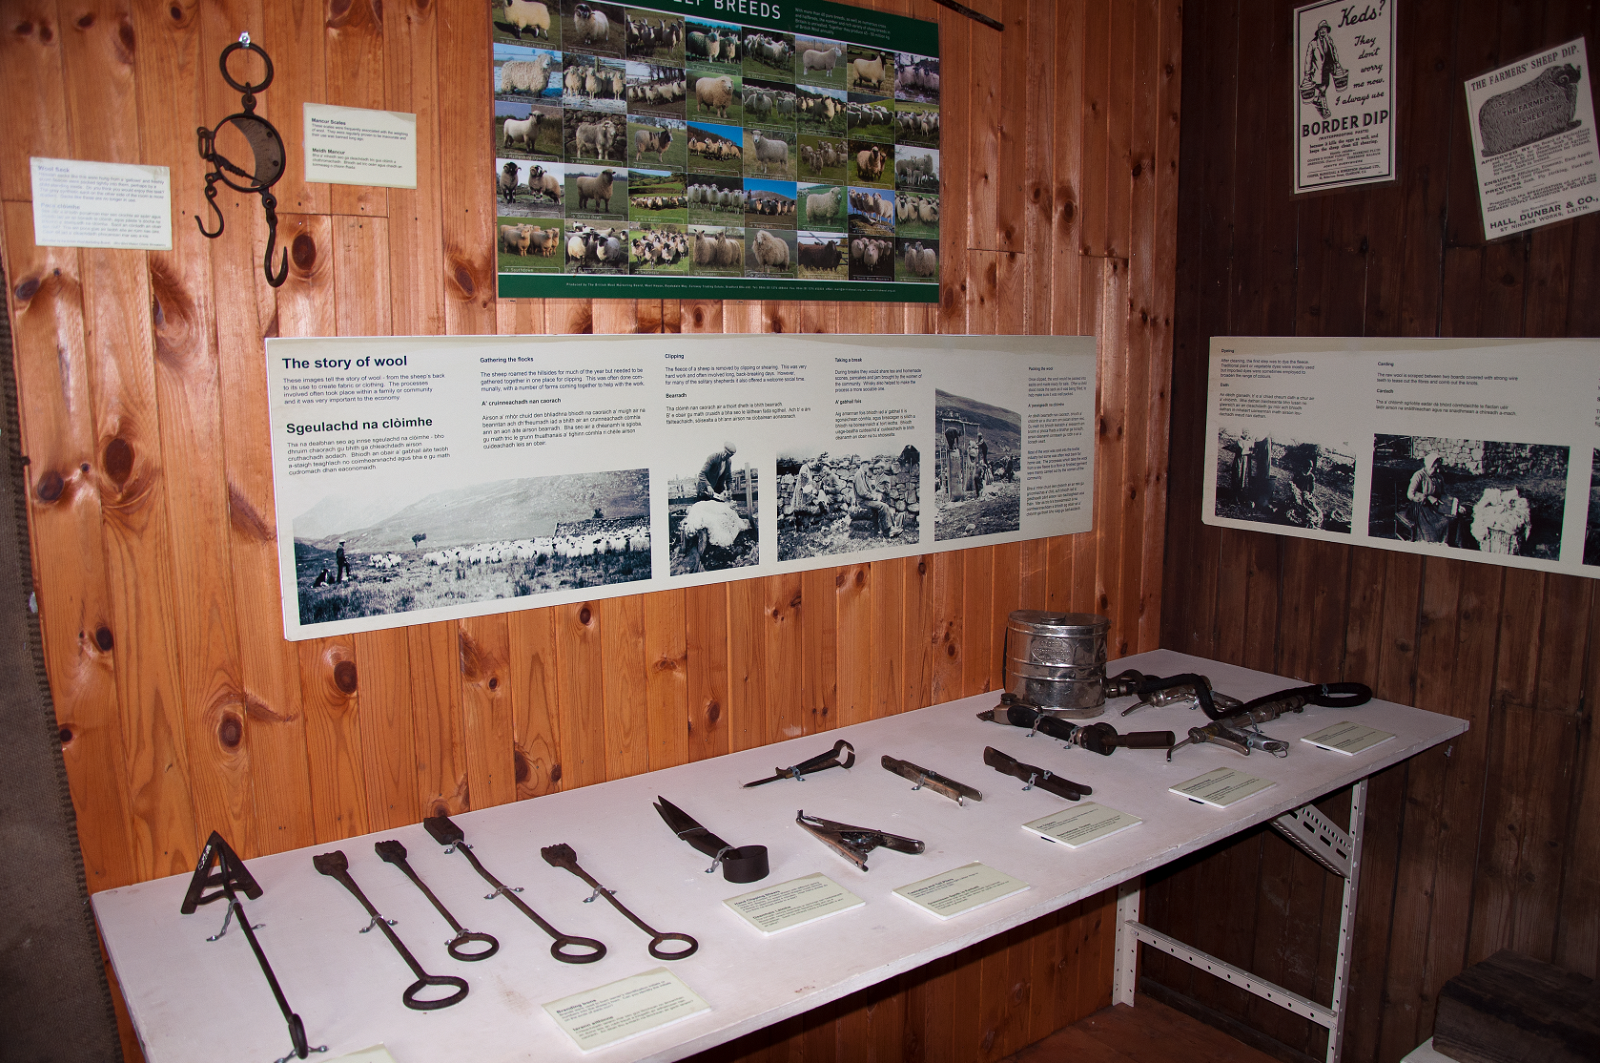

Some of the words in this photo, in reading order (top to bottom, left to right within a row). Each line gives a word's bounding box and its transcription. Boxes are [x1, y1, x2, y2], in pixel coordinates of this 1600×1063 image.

[714, 0, 780, 19] BREEDS
[1338, 0, 1385, 28] Keds?
[1354, 35, 1376, 47] They
[1358, 47, 1380, 59] don't
[1361, 64, 1383, 74] worry
[1471, 79, 1487, 91] THE
[1489, 63, 1529, 85] FARMERS'
[1531, 52, 1558, 69] SHEEP
[1562, 45, 1579, 58] DIP.
[1335, 96, 1341, 105] I
[1342, 94, 1369, 105] always
[1492, 101, 1506, 110] USE
[1502, 108, 1517, 116] THE
[1522, 111, 1547, 123] SHEEP
[1549, 104, 1562, 114] DIP
[1302, 115, 1359, 138] BORDER
[1363, 110, 1389, 127] DIP
[1481, 151, 1517, 164] APPROVED
[1484, 174, 1515, 186] ENSURES
[1485, 182, 1521, 194] PREVENTS
[1490, 218, 1516, 229] HALL,
[1520, 205, 1561, 221] DUNBAR
[1578, 196, 1599, 205] CO.,
[1511, 219, 1536, 229] NINIANS
[1539, 213, 1564, 222] WORKS,
[1567, 205, 1589, 214] LEITH.
[282, 358, 310, 369] The
[314, 357, 351, 370] story
[356, 356, 370, 367] of
[374, 356, 407, 366] wool
[286, 420, 358, 435] Sgeulachd
[382, 417, 433, 428] clòimhe
